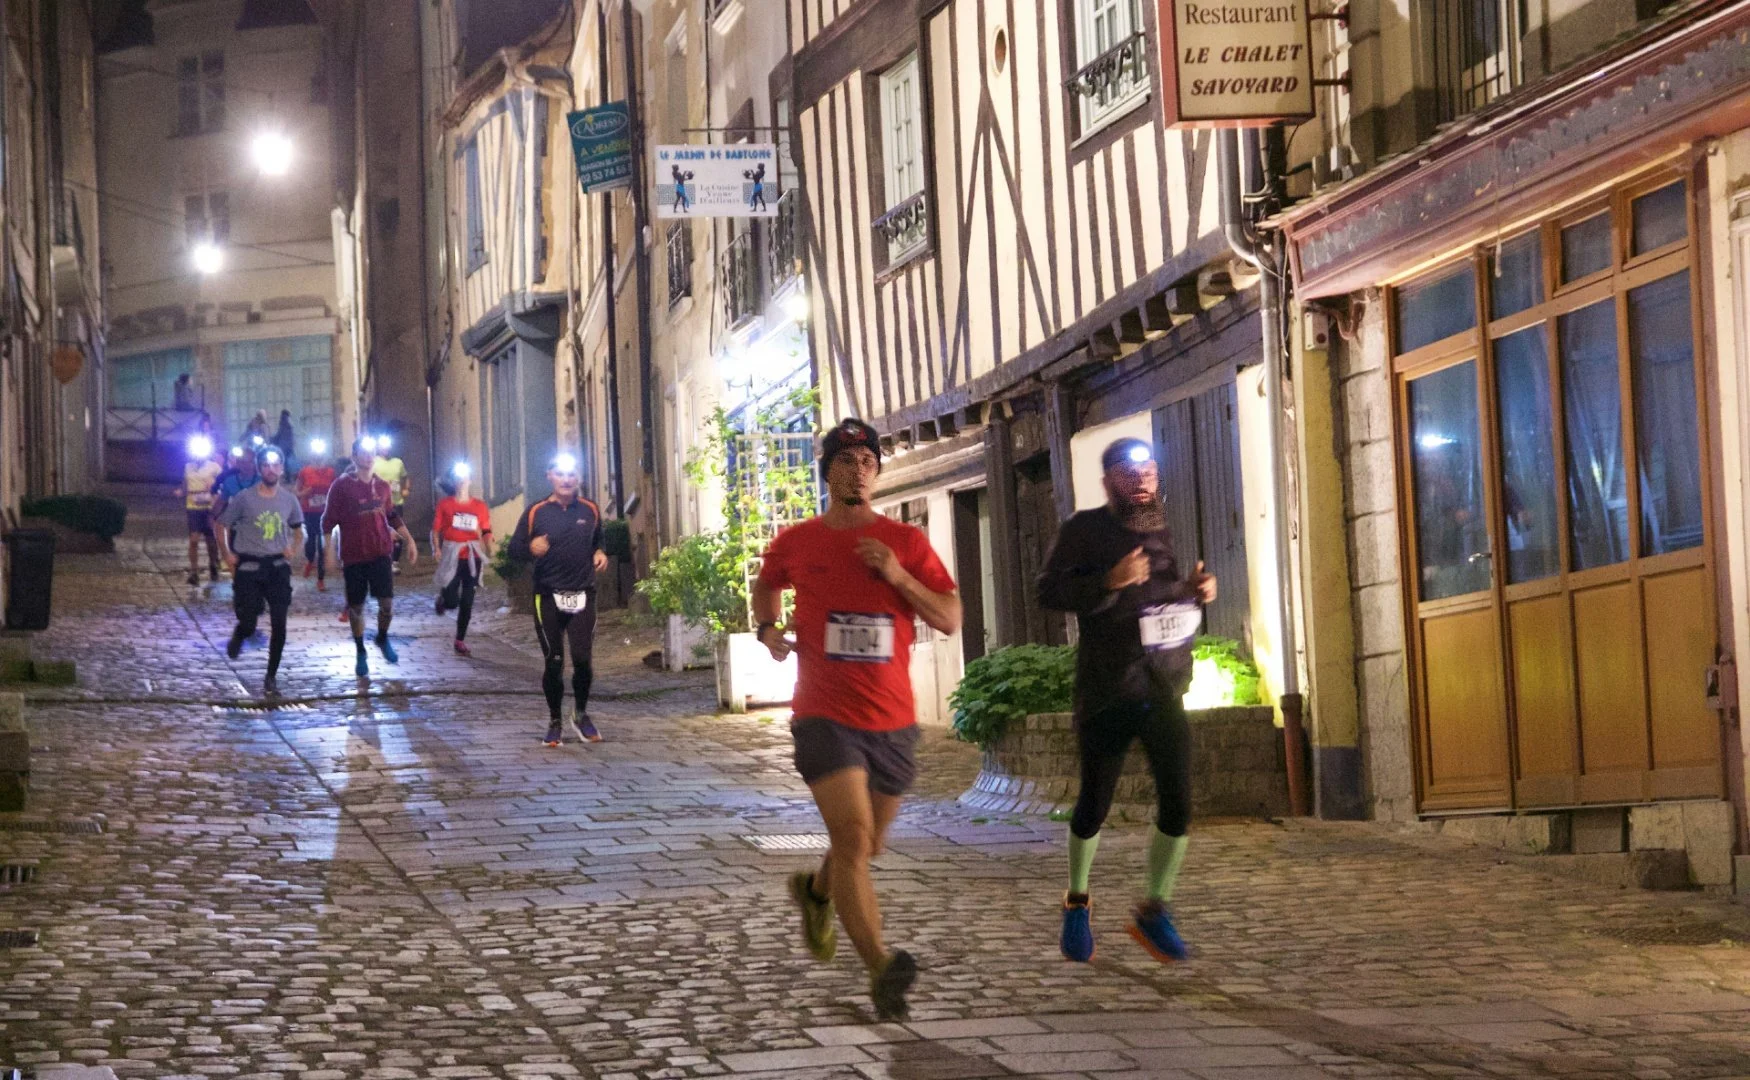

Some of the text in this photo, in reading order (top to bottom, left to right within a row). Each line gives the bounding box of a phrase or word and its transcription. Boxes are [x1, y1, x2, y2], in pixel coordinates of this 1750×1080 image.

[1185, 3, 1298, 25] Restaurant
[1184, 44, 1303, 64] LE CHALET
[1190, 76, 1299, 96] SAVOYARD
[659, 149, 670, 160] LE
[674, 149, 706, 160] JARDIN
[710, 149, 722, 160] DE
